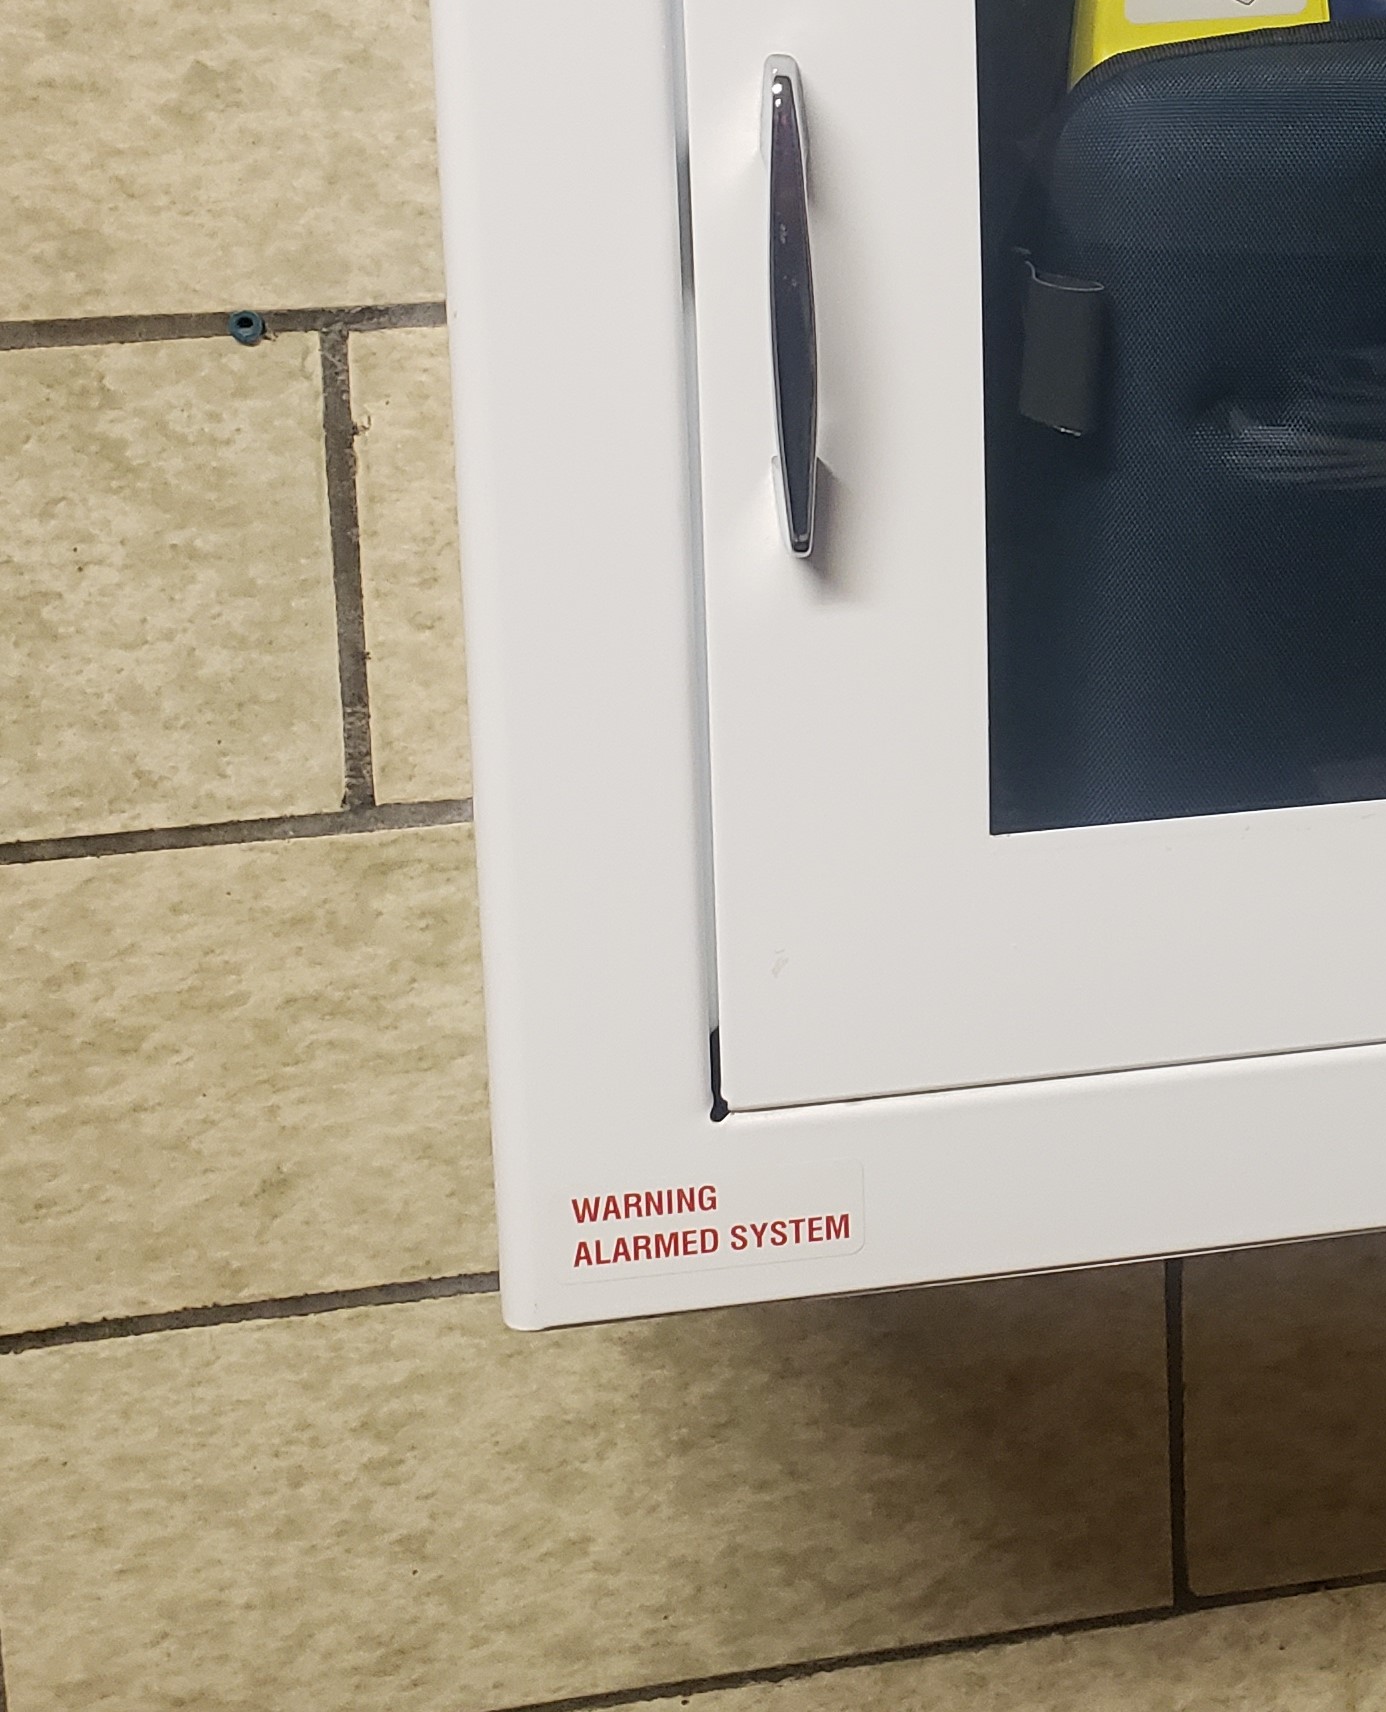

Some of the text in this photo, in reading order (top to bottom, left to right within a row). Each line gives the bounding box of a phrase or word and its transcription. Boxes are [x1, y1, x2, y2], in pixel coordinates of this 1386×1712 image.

[571, 1185, 717, 1224] WARNING
[573, 1213, 851, 1268] ALARMED SYSTEM
